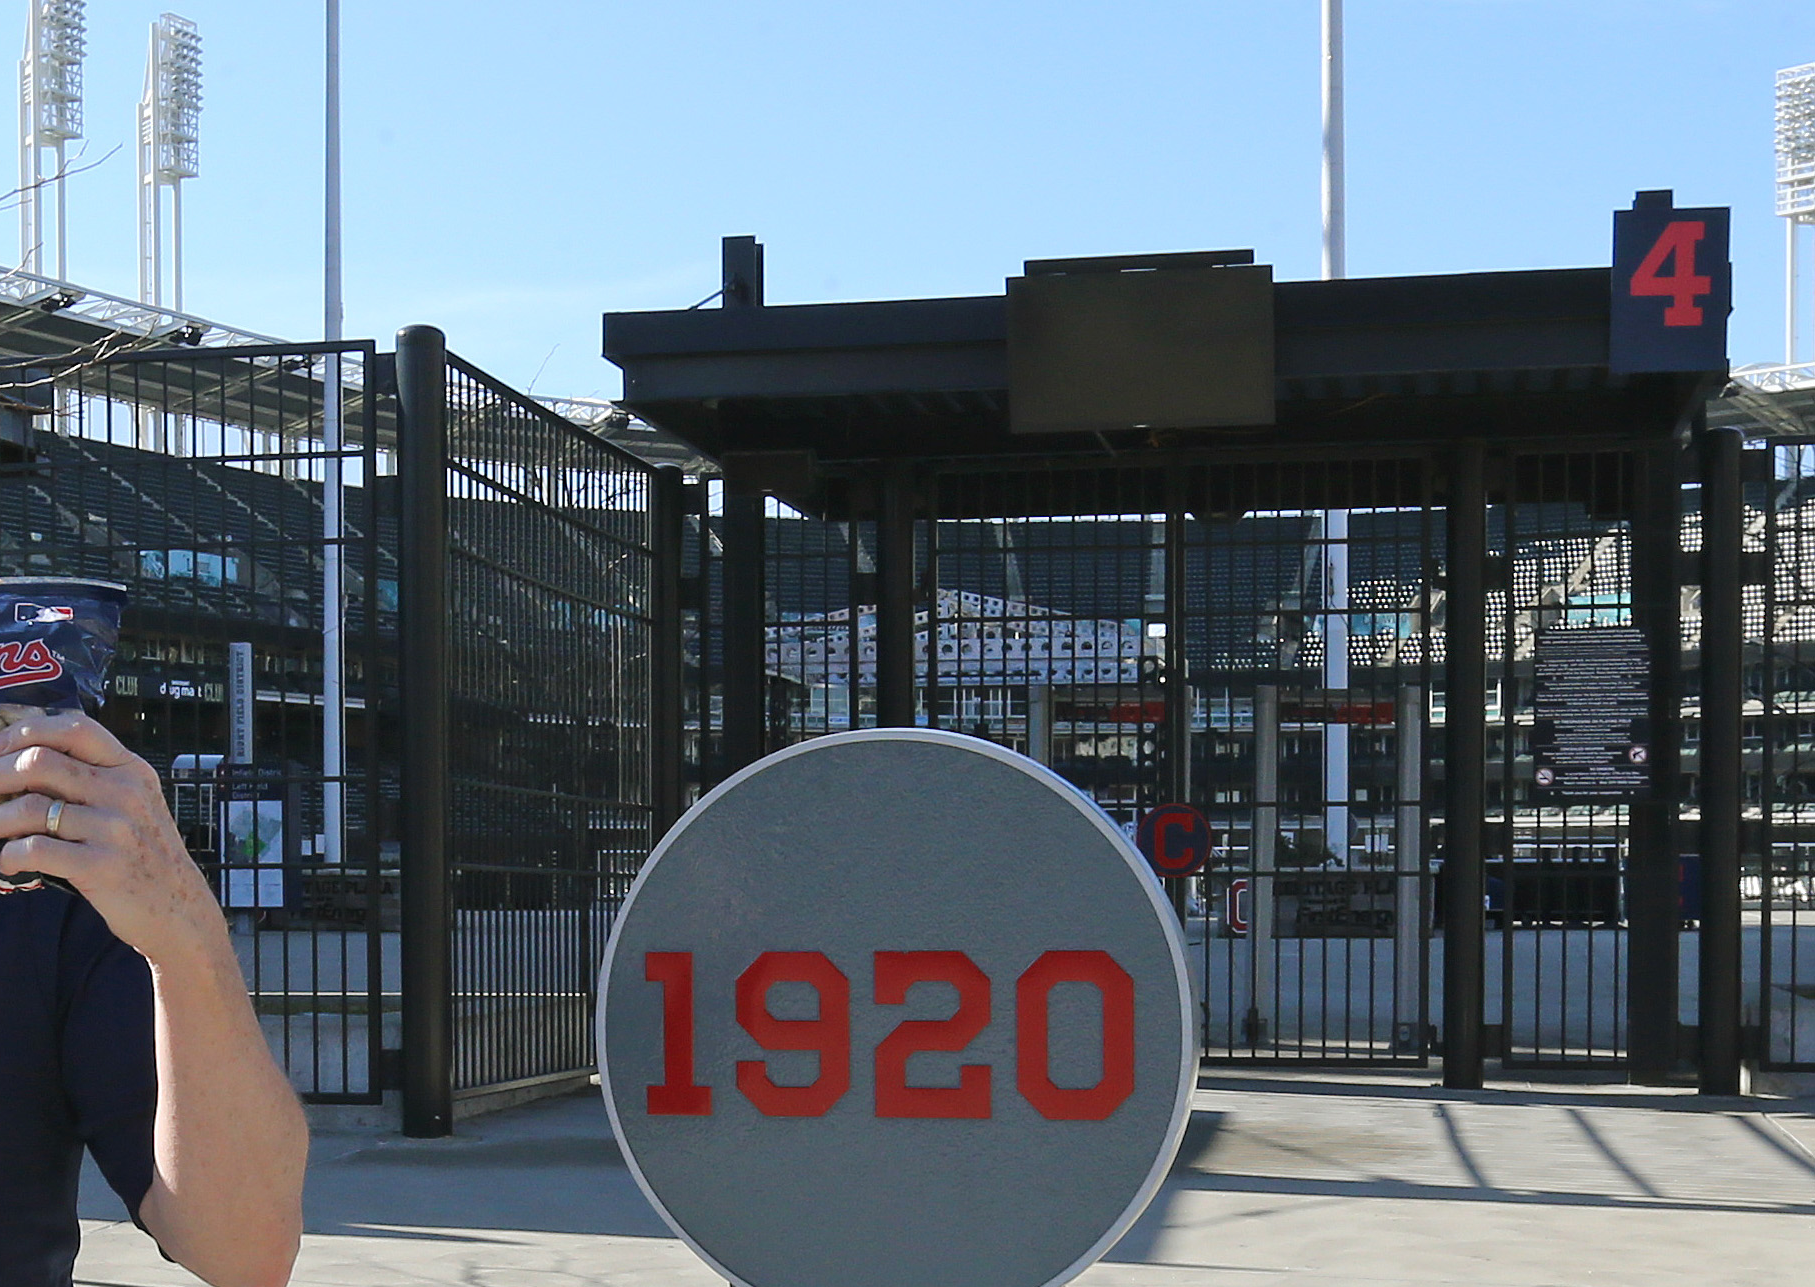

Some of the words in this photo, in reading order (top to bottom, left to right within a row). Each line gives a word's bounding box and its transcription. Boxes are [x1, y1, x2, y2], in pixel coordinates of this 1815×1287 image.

[1629, 220, 1711, 327] 4
[1154, 812, 1194, 869] C
[645, 949, 1136, 1122] 1920
